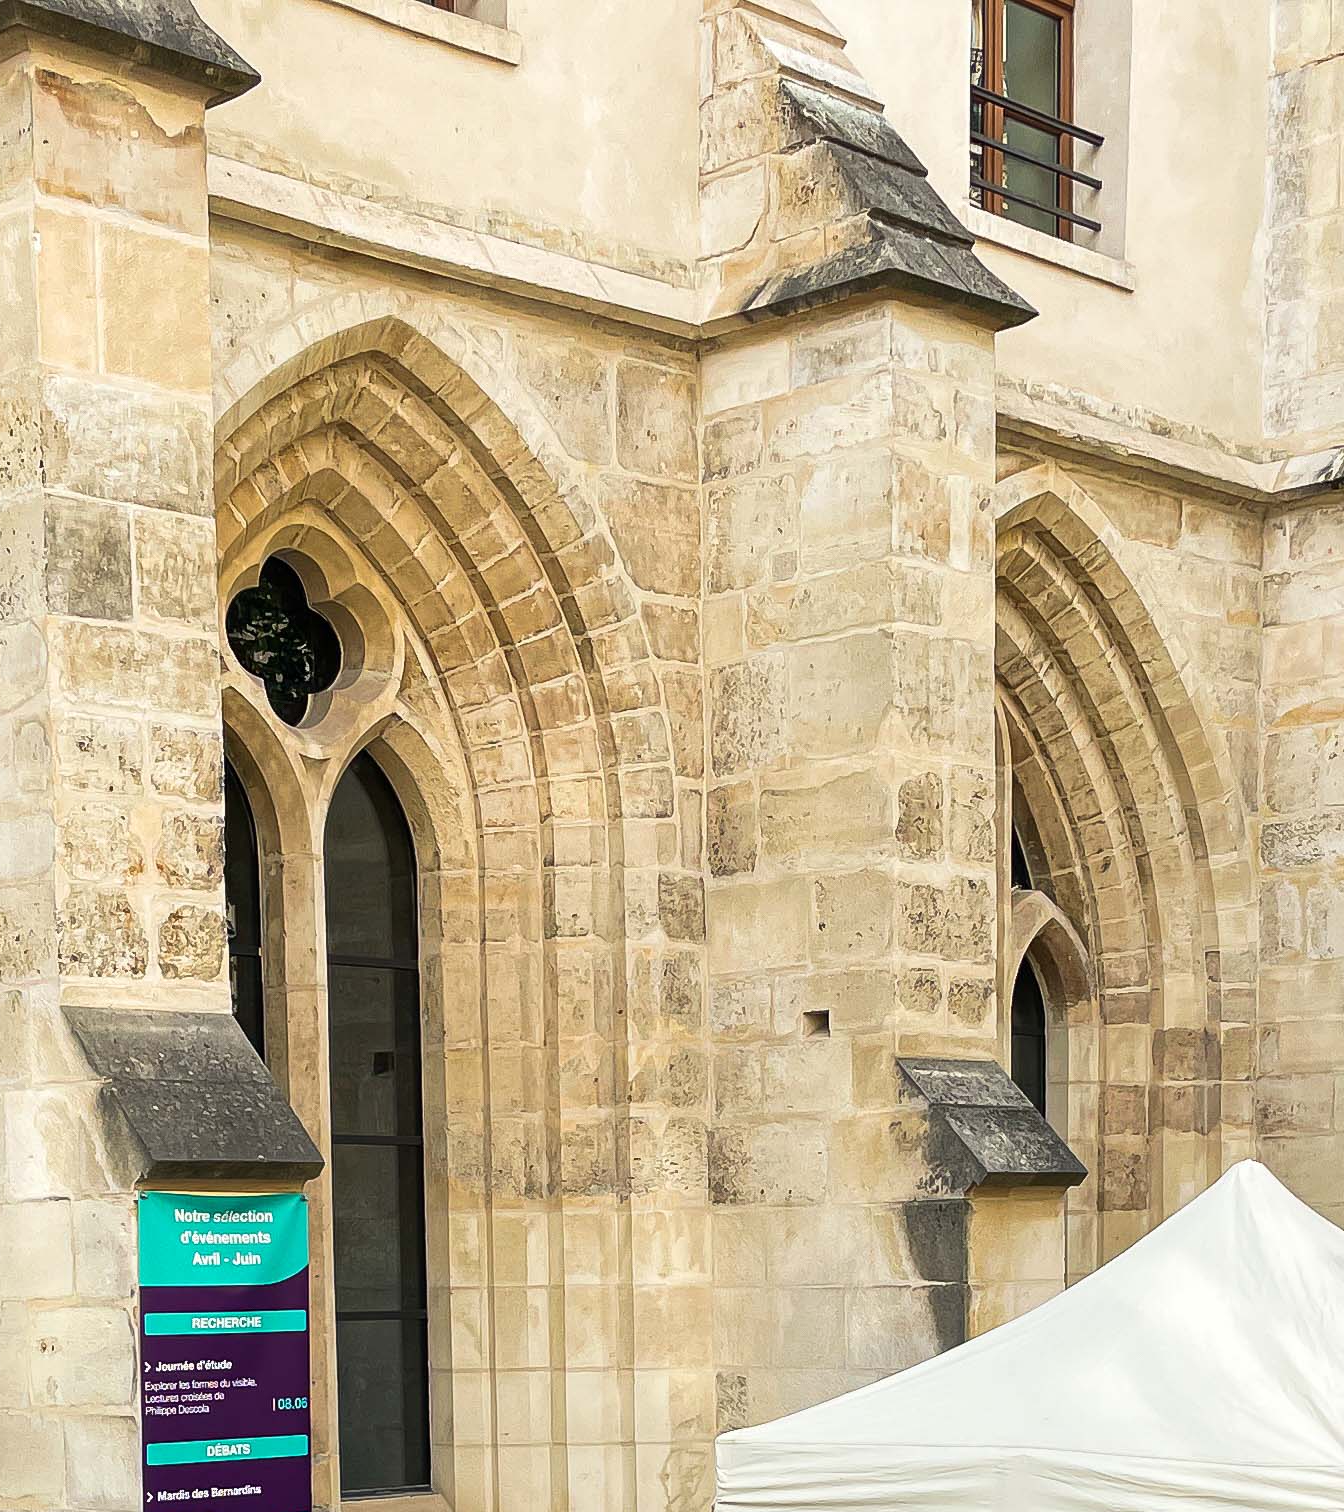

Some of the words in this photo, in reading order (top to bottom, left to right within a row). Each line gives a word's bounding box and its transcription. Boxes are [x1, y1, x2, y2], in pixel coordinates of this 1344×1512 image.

[175, 1209, 210, 1223] Notre
[213, 1209, 273, 1223] sélection
[180, 1230, 271, 1245] d'événements
[192, 1252, 220, 1266] Avril
[232, 1252, 261, 1266] Juin
[192, 1316, 262, 1330] RECHERCHE
[156, 1361, 194, 1372] Journée
[197, 1360, 233, 1371] d'étude
[191, 1380, 218, 1389] formes
[220, 1379, 230, 1388] du
[207, 1443, 251, 1457] DÉBATS
[158, 1490, 190, 1502] Mardis
[192, 1488, 209, 1499] des
[211, 1485, 262, 1497] Bernardins
